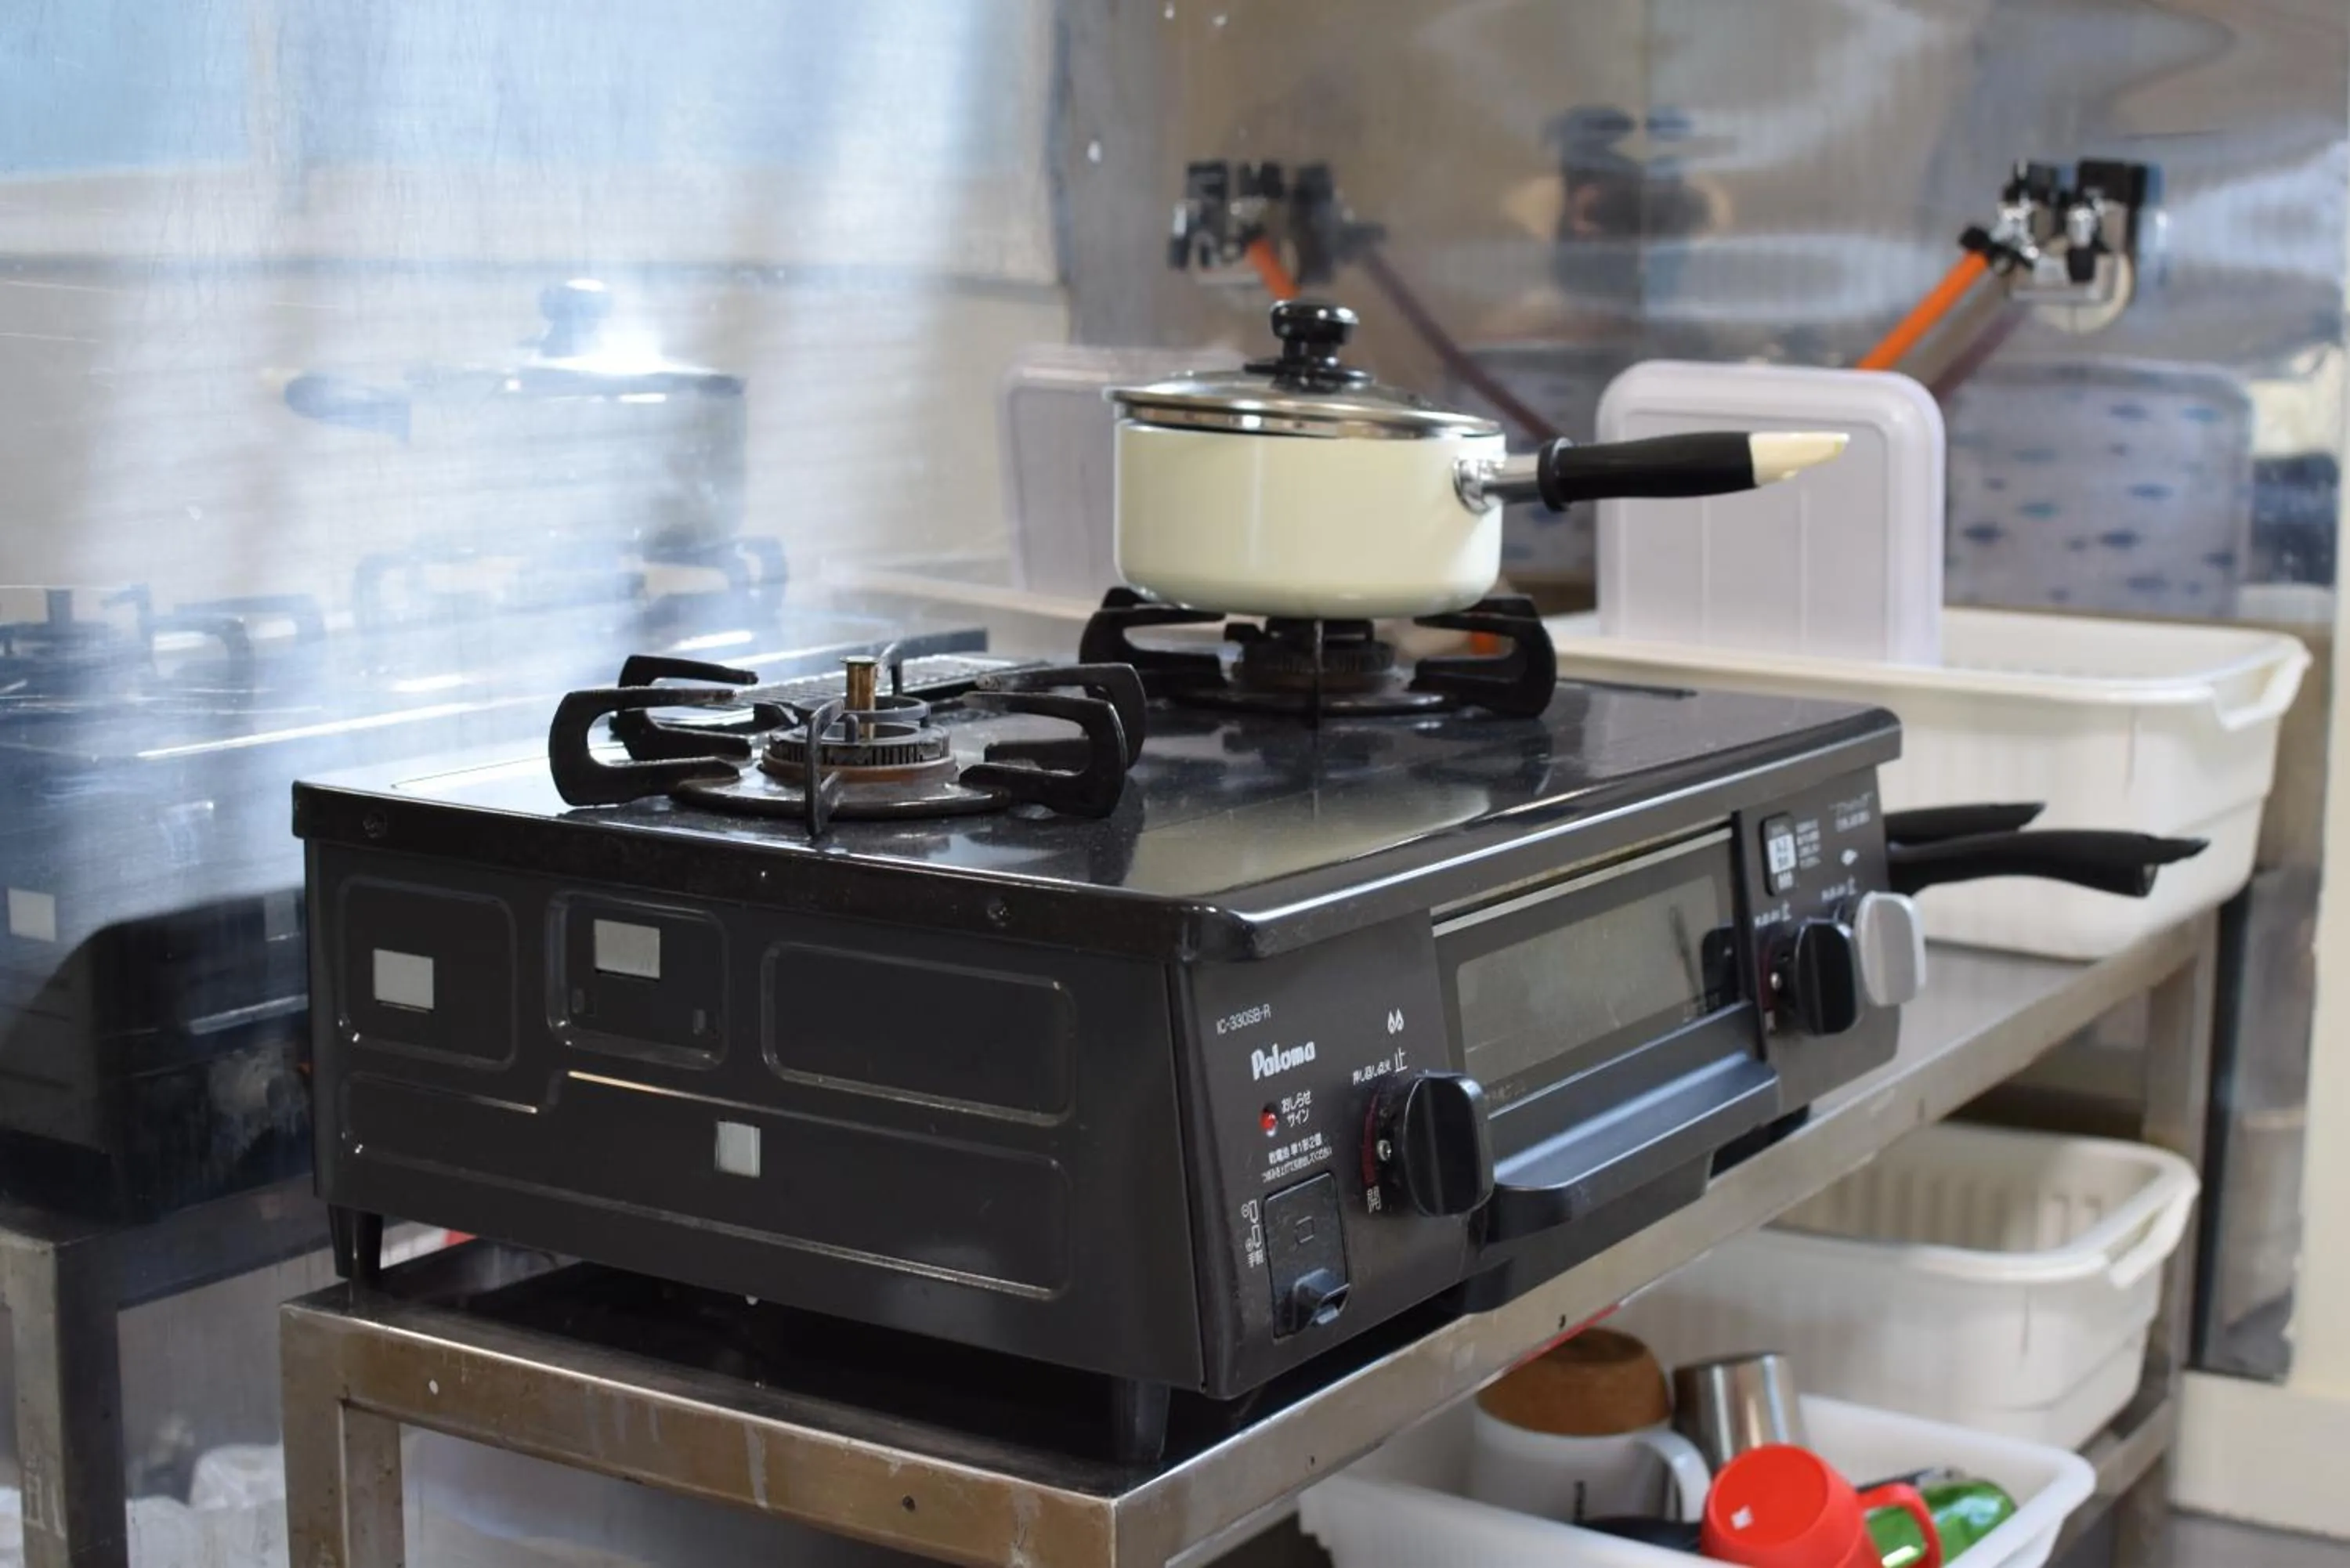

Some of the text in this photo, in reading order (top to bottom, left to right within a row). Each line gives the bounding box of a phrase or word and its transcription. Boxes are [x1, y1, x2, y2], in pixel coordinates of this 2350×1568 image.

[1217, 1003, 1271, 1035] IC-330SB-R
[1251, 1041, 1316, 1081] Paloma
[1394, 1046, 1408, 1072] 止
[1282, 1089, 1311, 1114] おしらせ
[1287, 1108, 1309, 1128] サイン
